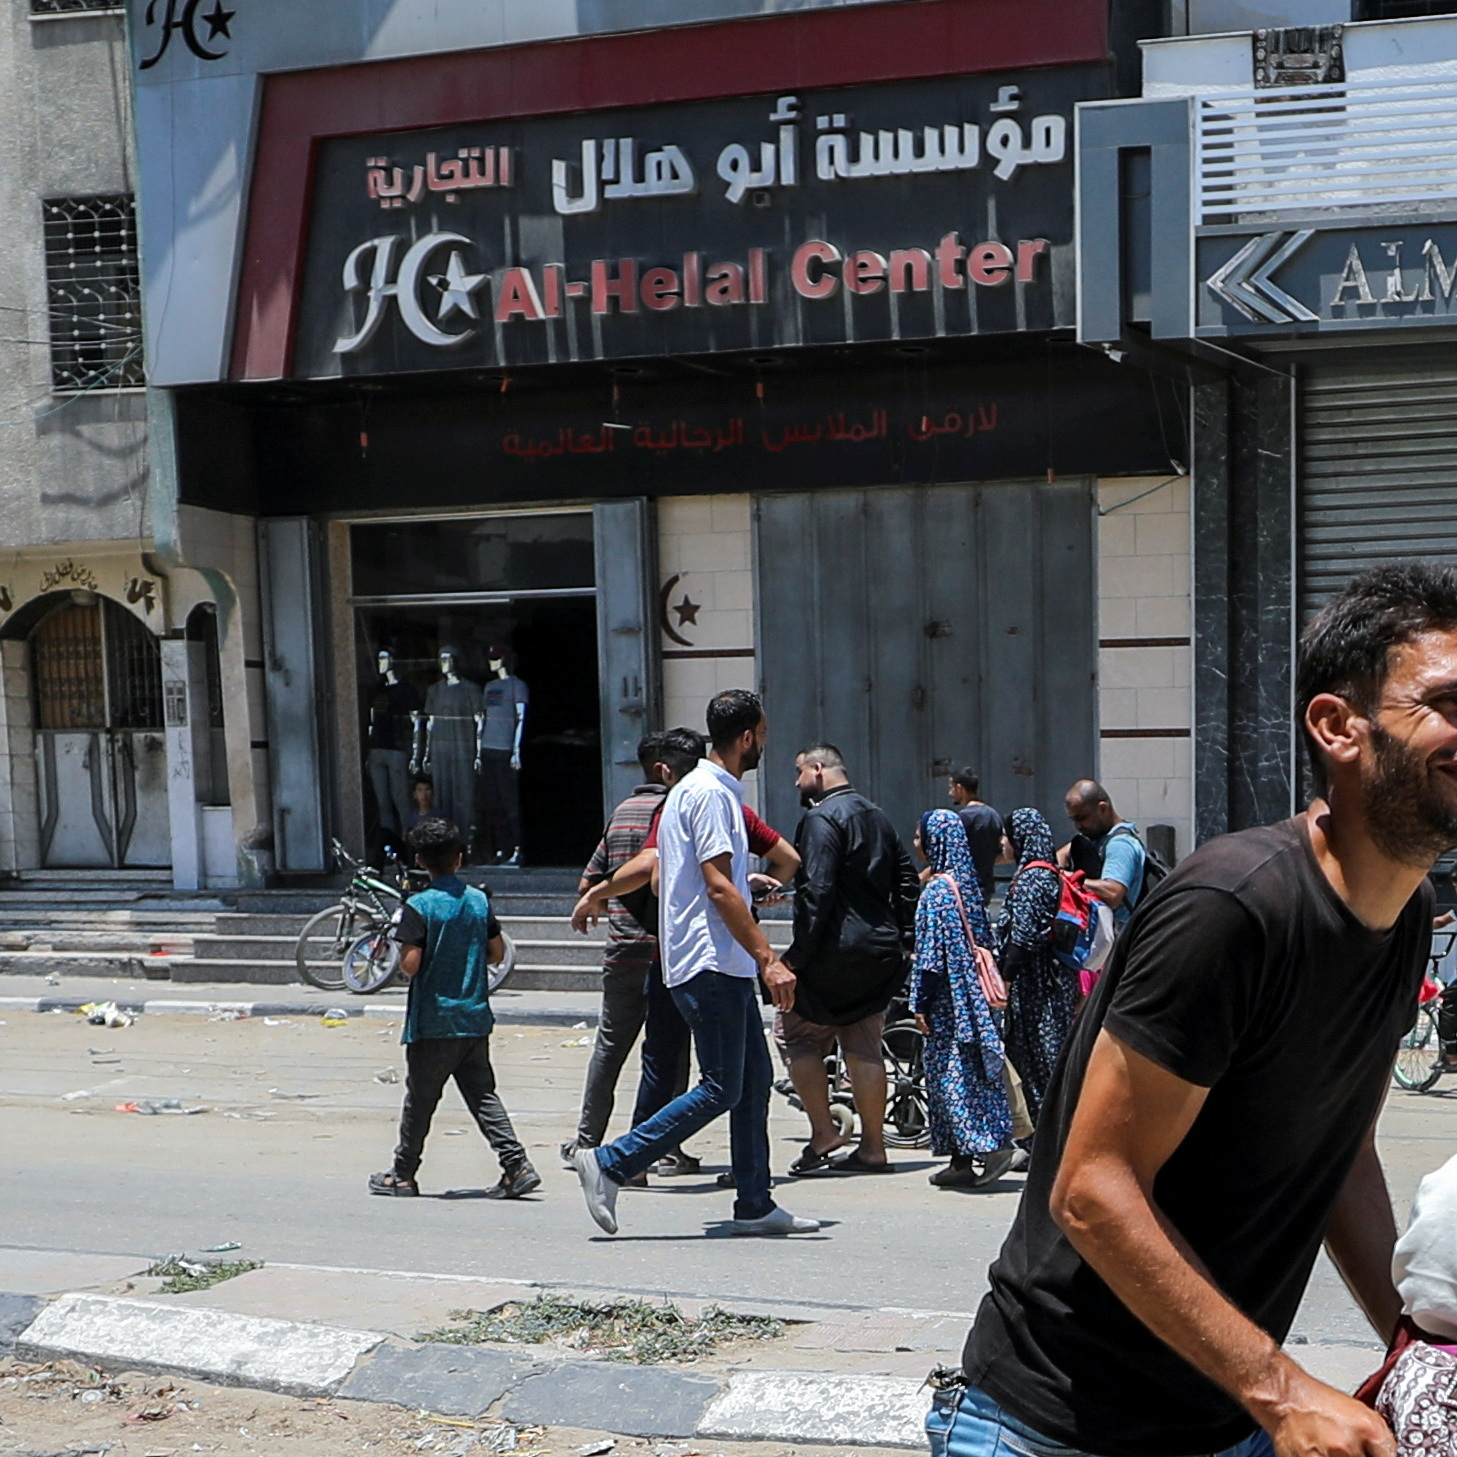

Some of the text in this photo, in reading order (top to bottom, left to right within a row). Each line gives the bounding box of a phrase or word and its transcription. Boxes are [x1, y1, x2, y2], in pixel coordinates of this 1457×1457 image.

[366, 85, 1066, 215] مؤسسة أبو هلال التجارية
[494, 231, 1051, 323] Al-Helal Center
